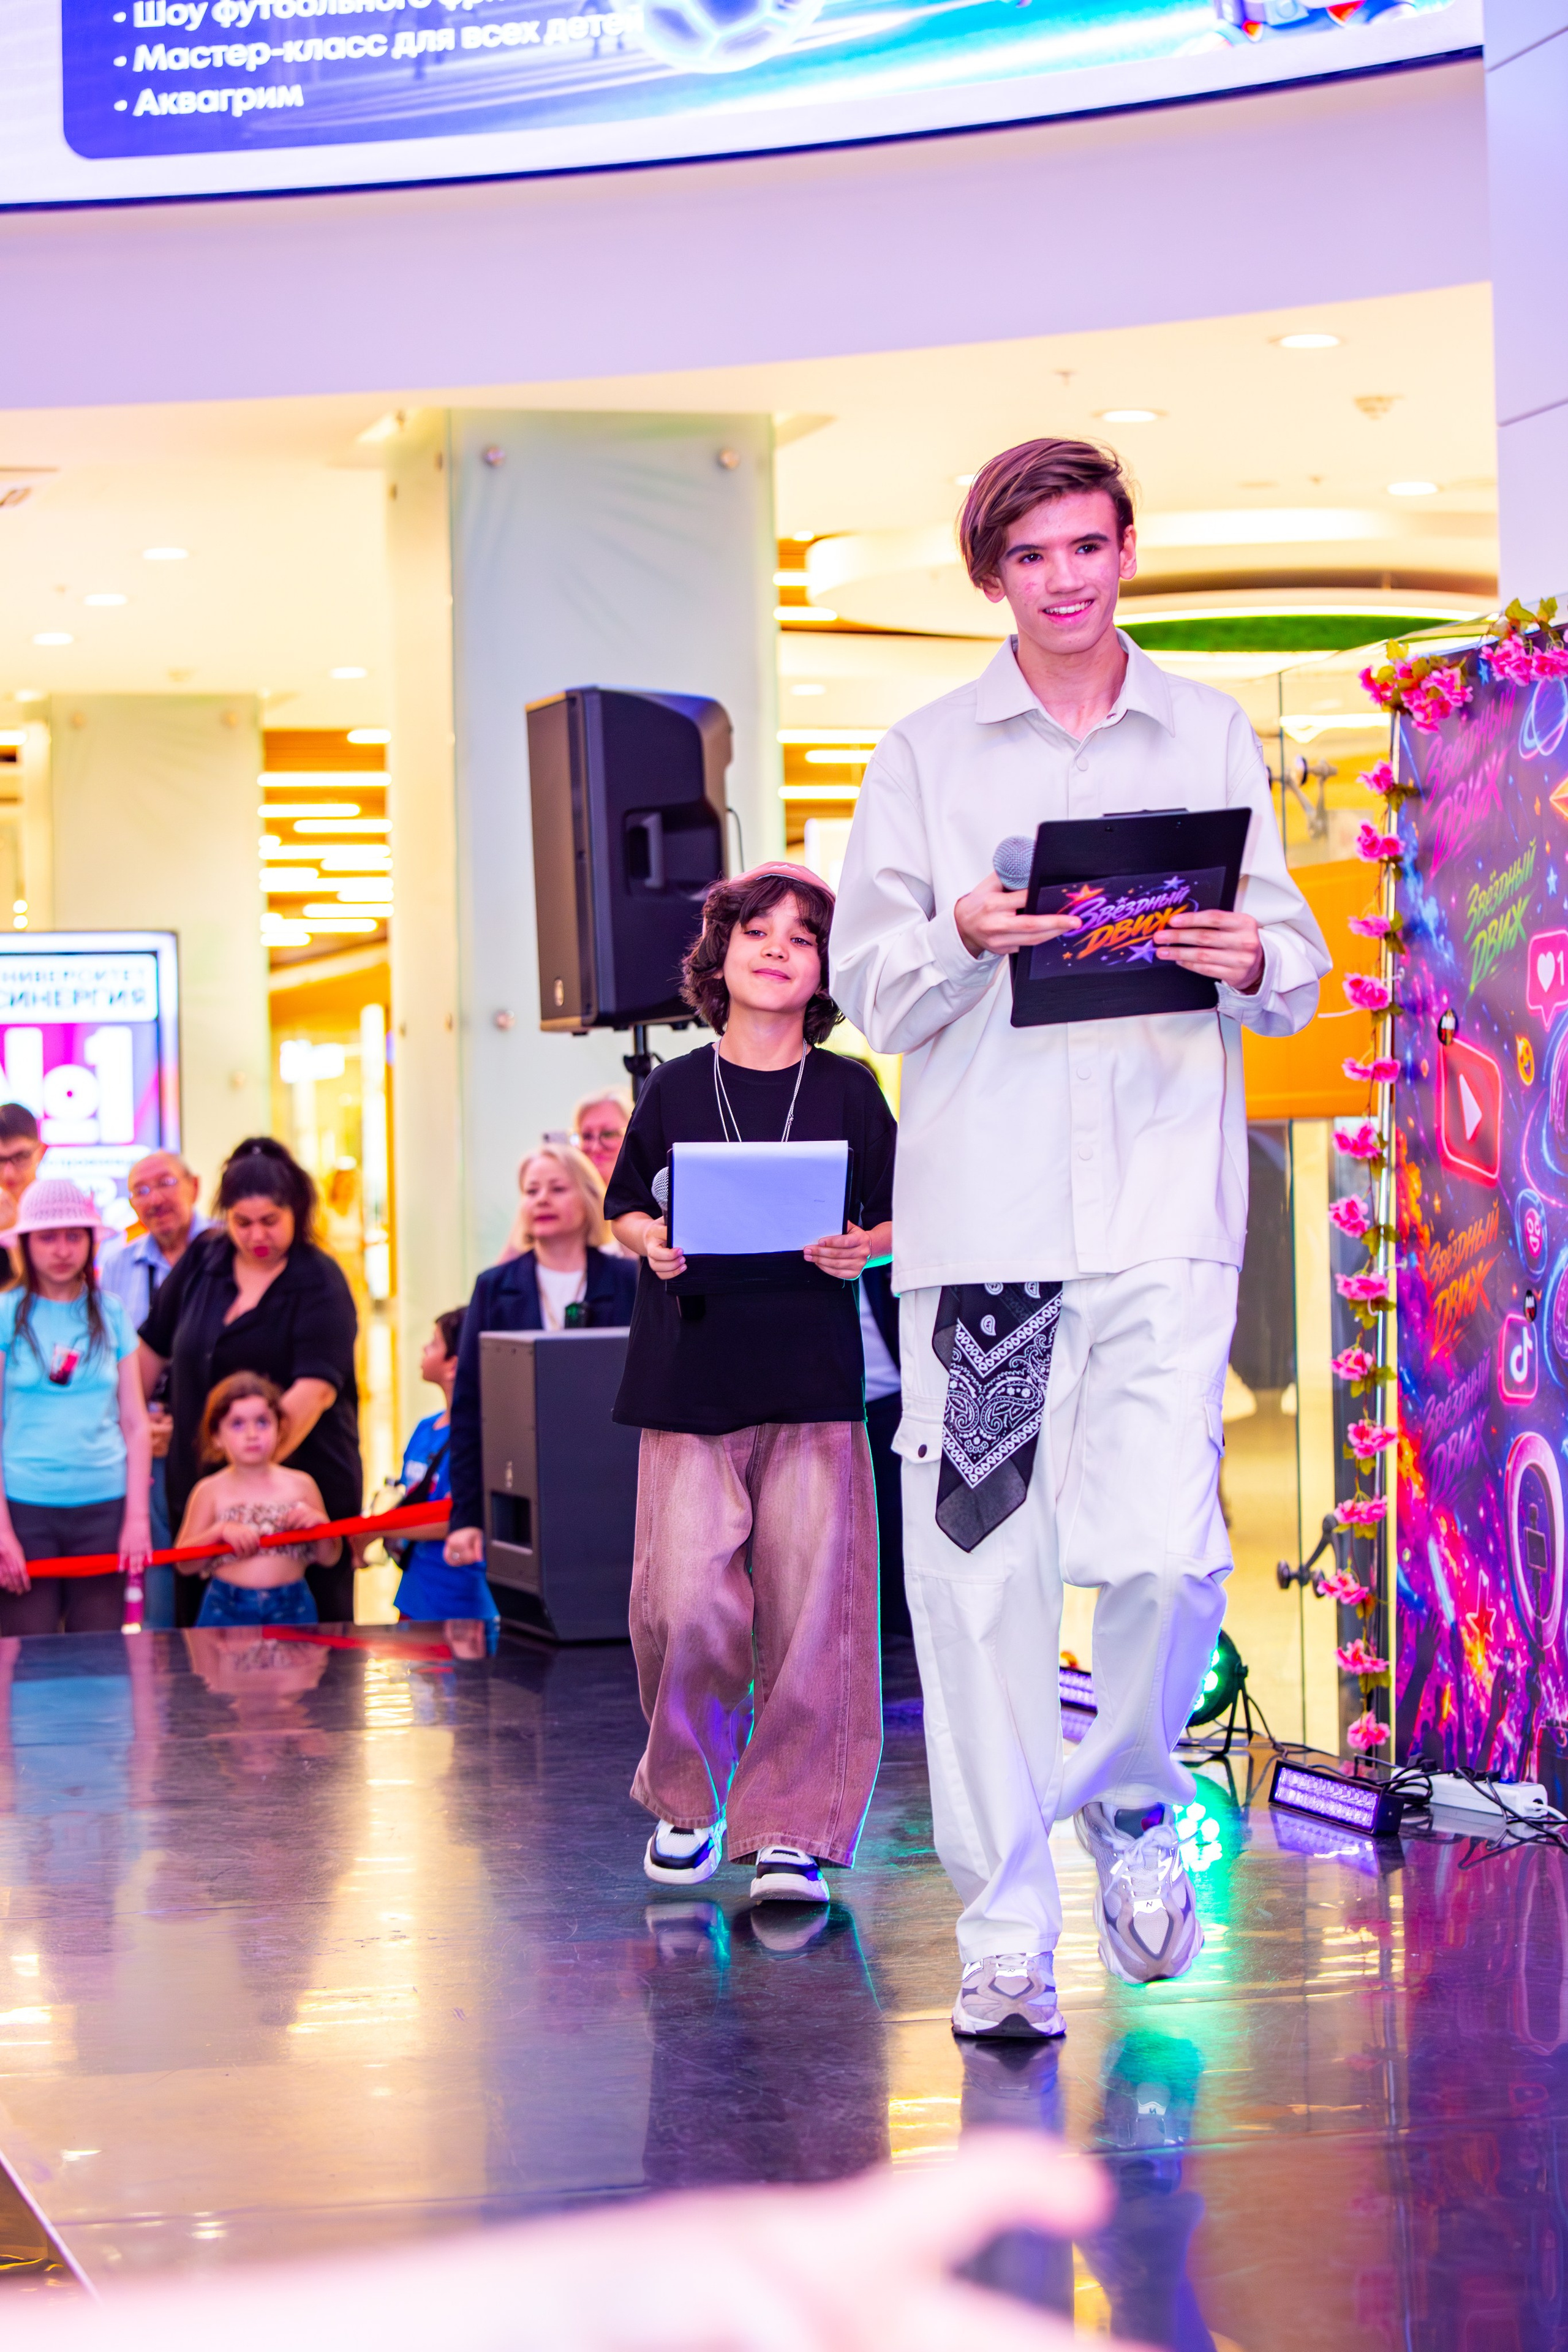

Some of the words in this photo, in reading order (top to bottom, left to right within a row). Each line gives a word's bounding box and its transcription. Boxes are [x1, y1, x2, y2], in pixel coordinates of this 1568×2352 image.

[134, 0, 208, 31] Шоу
[133, 34, 388, 72] Мастер-класс
[391, 28, 455, 59] для
[461, 20, 540, 48] всех
[543, 5, 644, 46] детей
[132, 84, 304, 117] Аквагрим
[1, 968, 146, 982] НИВЕРСИТЕТ
